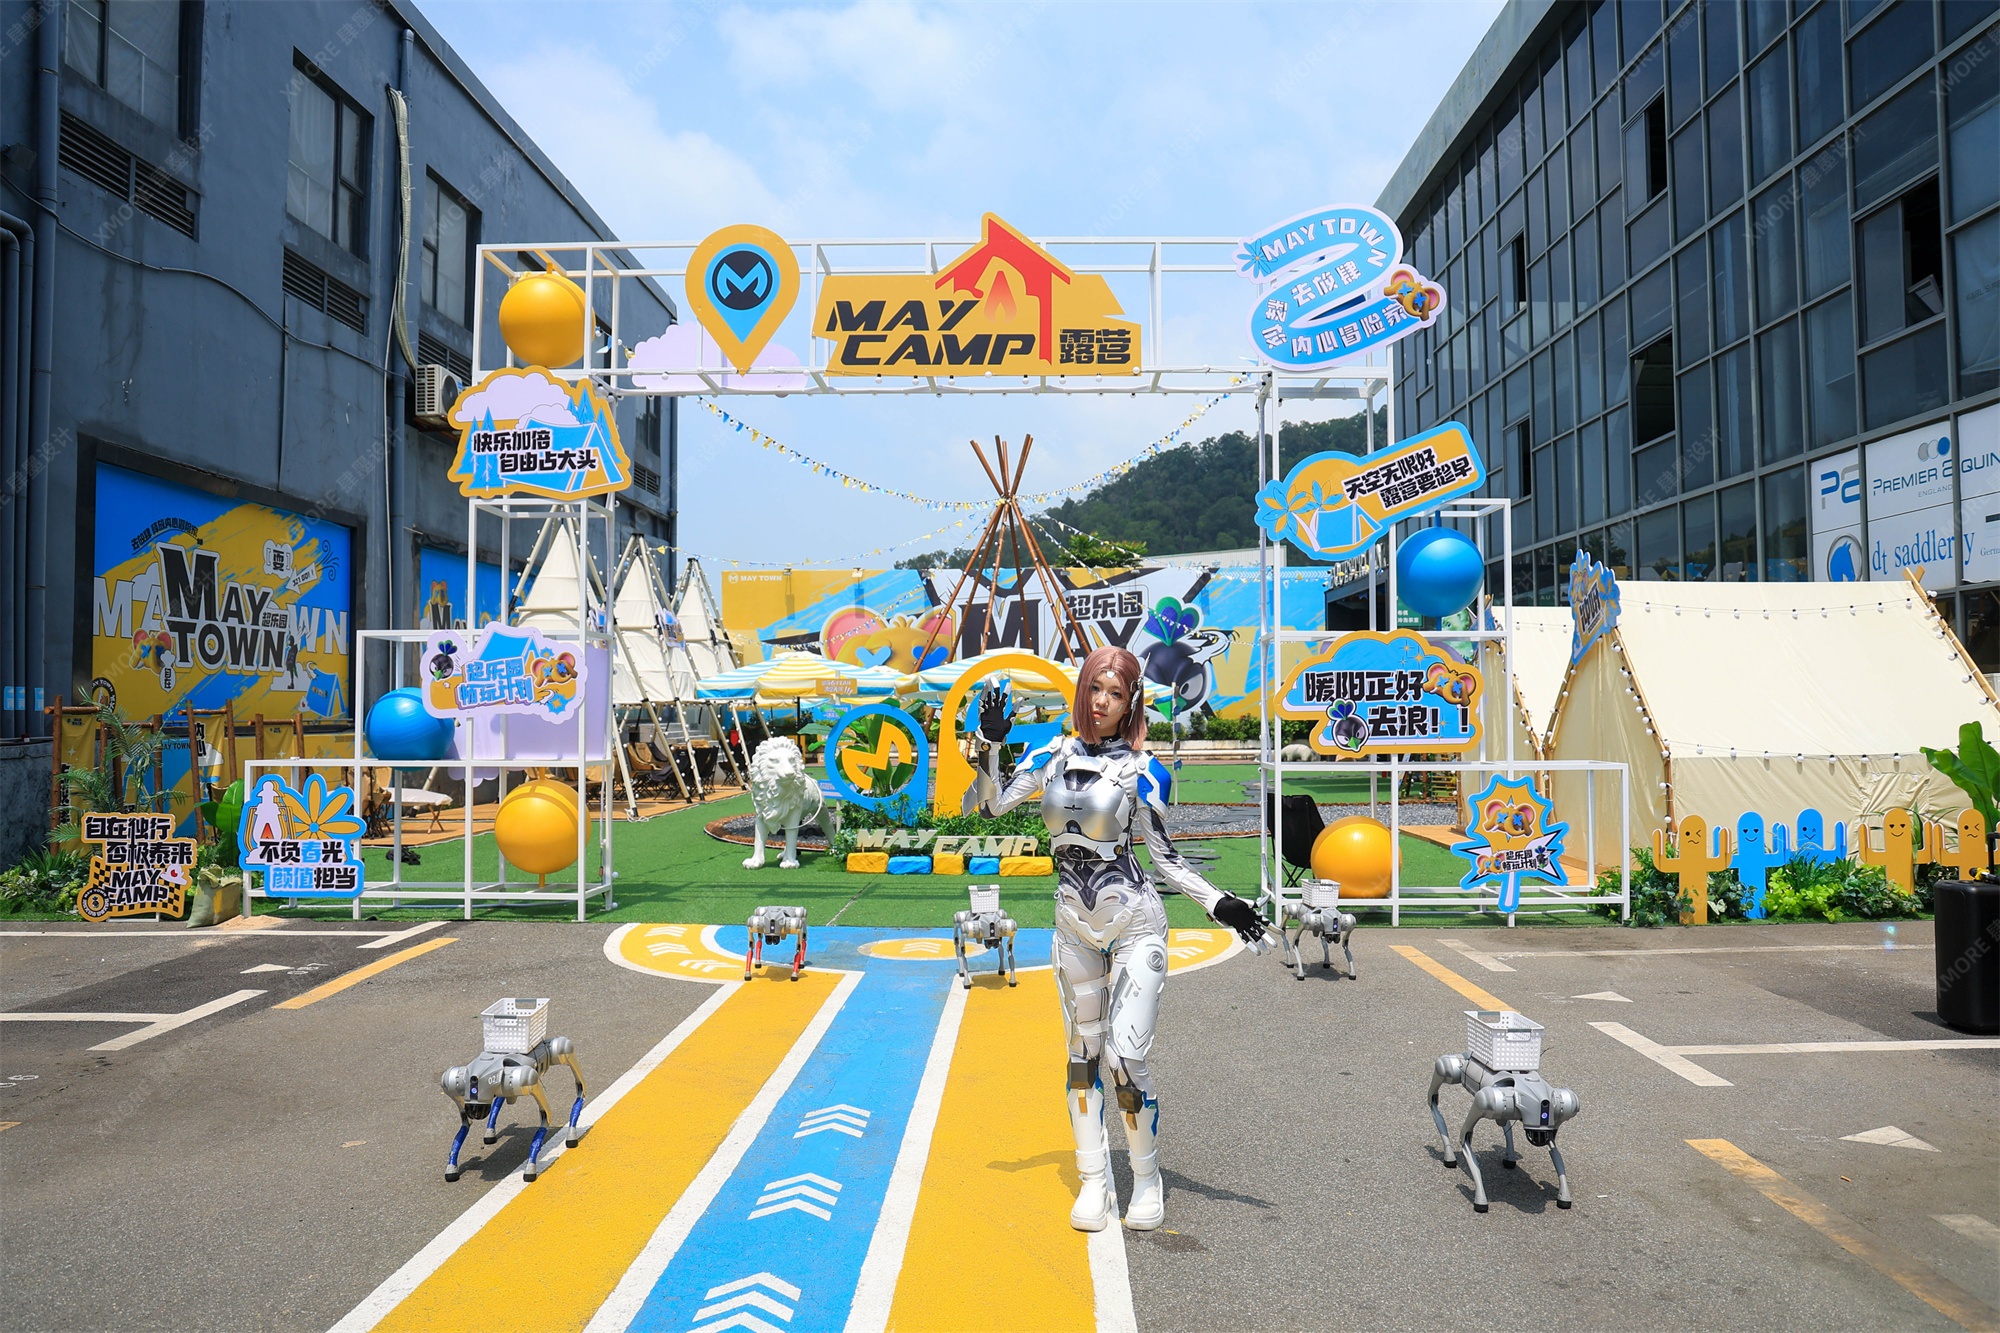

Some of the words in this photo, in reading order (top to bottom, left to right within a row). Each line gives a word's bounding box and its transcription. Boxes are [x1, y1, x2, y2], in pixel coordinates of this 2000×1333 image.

[1262, 223, 1315, 262] MAY
[1321, 217, 1388, 267] TOWN
[826, 300, 980, 332] MAY
[840, 334, 1036, 365] CAMP
[1059, 329, 1131, 364] 露营
[473, 430, 550, 452] 快乐加倍
[500, 450, 597, 473] 自由占大头
[1343, 447, 1436, 500] 天空无限好
[1873, 467, 1938, 496] PREMIER
[1873, 540, 1888, 575] dt
[160, 547, 271, 625] MAY
[1066, 591, 1142, 619] 超乐园
[169, 622, 287, 671] TOWN
[466, 658, 523, 682] 超乐园
[460, 676, 534, 706] 畅玩计划
[1305, 670, 1425, 702] 暖阳正好
[86, 817, 171, 839] 自在独行
[856, 830, 938, 848] MAY
[107, 842, 192, 865] 否极泰来
[259, 841, 343, 863] 不负春光
[111, 870, 161, 887] MAY
[272, 867, 356, 889] 颜值担当
